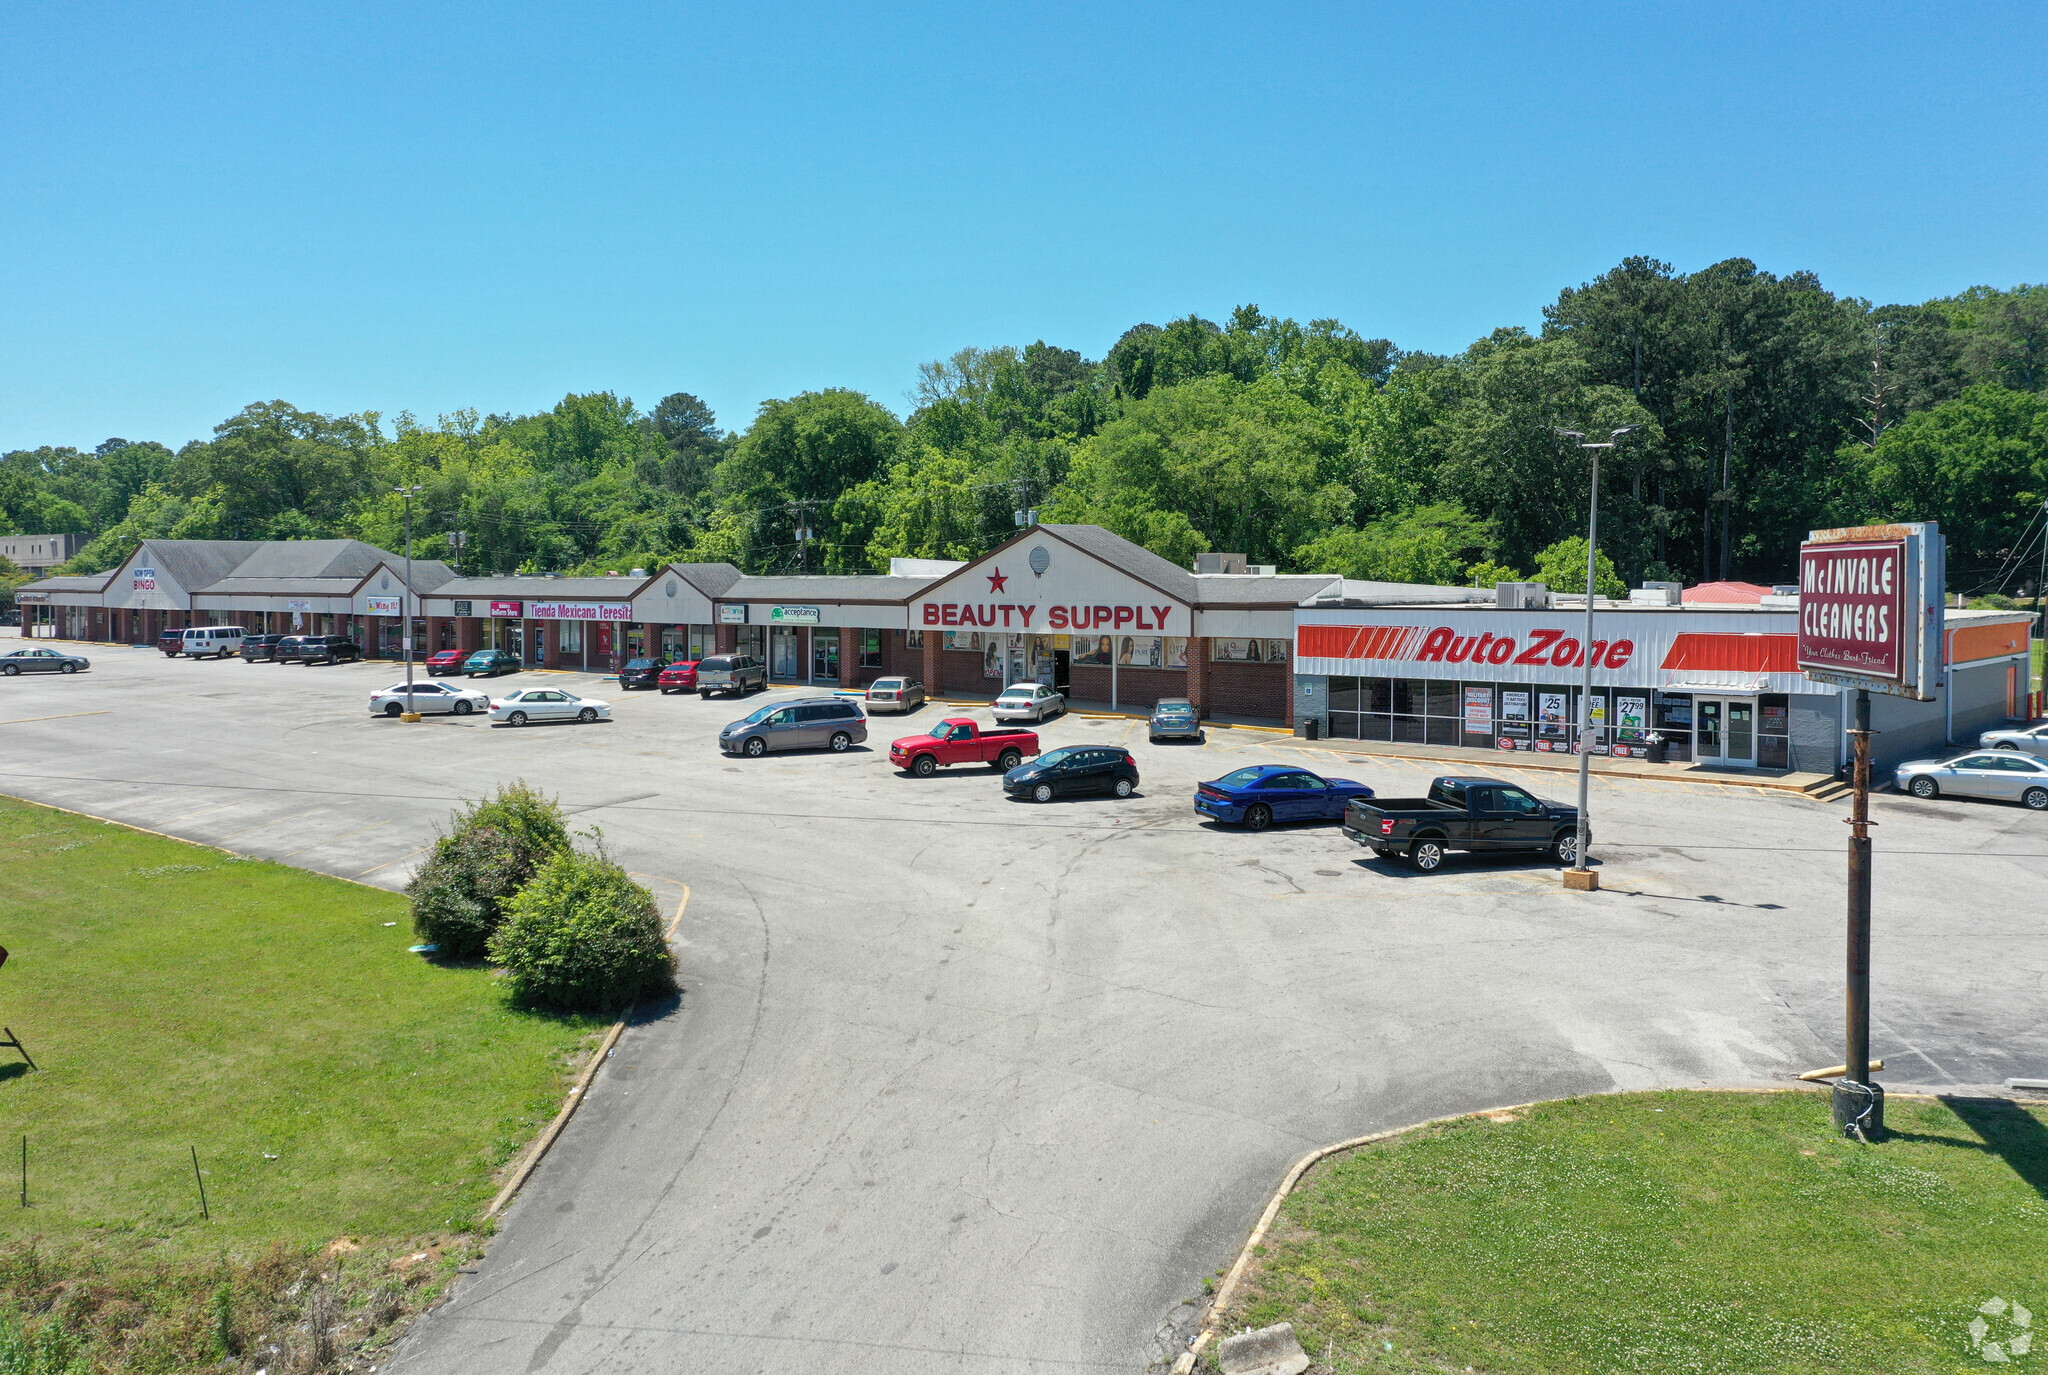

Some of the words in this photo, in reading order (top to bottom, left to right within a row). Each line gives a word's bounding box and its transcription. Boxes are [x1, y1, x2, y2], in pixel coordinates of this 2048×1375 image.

[1803, 557, 1892, 595] McINVALE
[133, 580, 155, 590] BINGO
[531, 604, 556, 618] Tienda
[558, 604, 597, 619] Mexicana
[598, 604, 632, 620] Teresita
[784, 607, 817, 618] acceptance
[923, 603, 1036, 628] BEAUTY
[1048, 605, 1172, 630] SUPPLY
[1804, 602, 1888, 643] CLEANERS
[1416, 626, 1634, 669] AutoZone
[1820, 648, 1840, 660] Clothes
[1843, 650, 1858, 662] Best
[1544, 698, 1560, 709] $25
